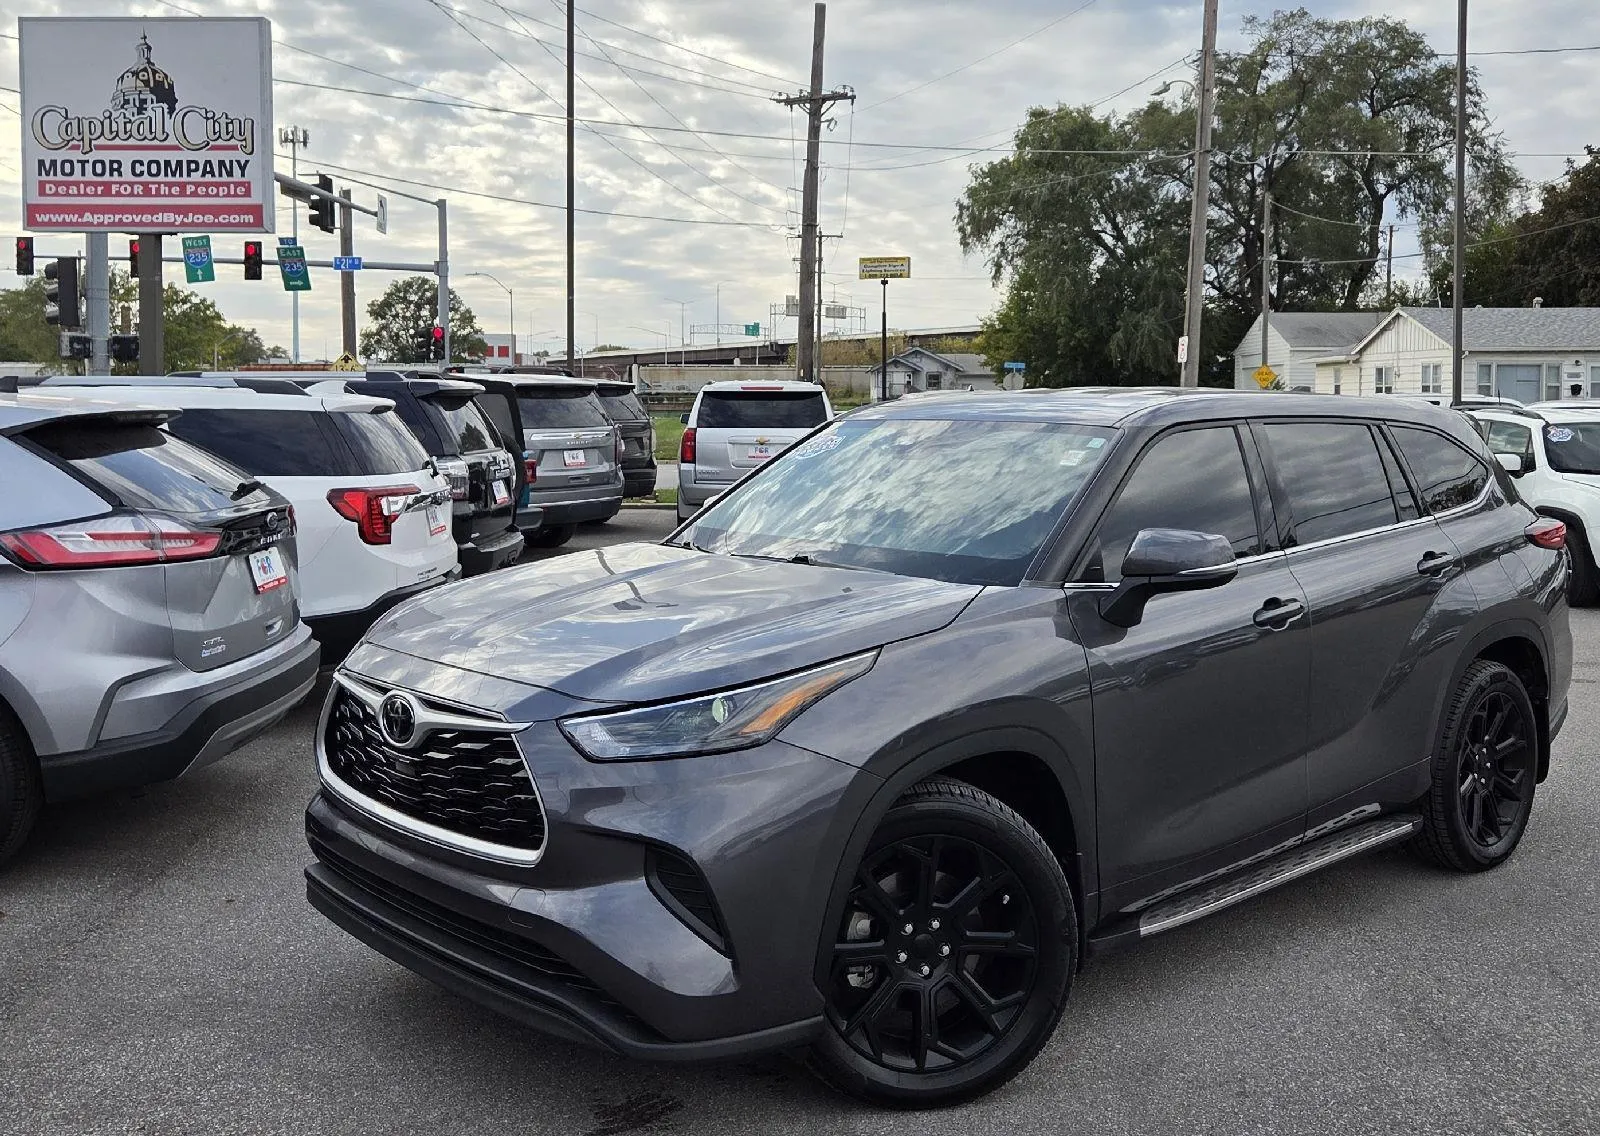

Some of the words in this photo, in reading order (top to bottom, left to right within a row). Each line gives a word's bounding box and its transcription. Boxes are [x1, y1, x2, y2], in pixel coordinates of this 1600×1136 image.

[32, 104, 169, 155] Capital
[173, 105, 255, 156] City
[37, 158, 123, 178] MOTOR
[130, 158, 250, 178] COMPANY
[45, 182, 104, 195] Dealer
[111, 183, 144, 195] FOR
[148, 183, 180, 195] The
[186, 183, 246, 197] People
[35, 211, 254, 226] www.ApprovedByJoe.com
[184, 239, 208, 247] WEST
[189, 252, 208, 263] 235
[284, 262, 303, 272] 235
